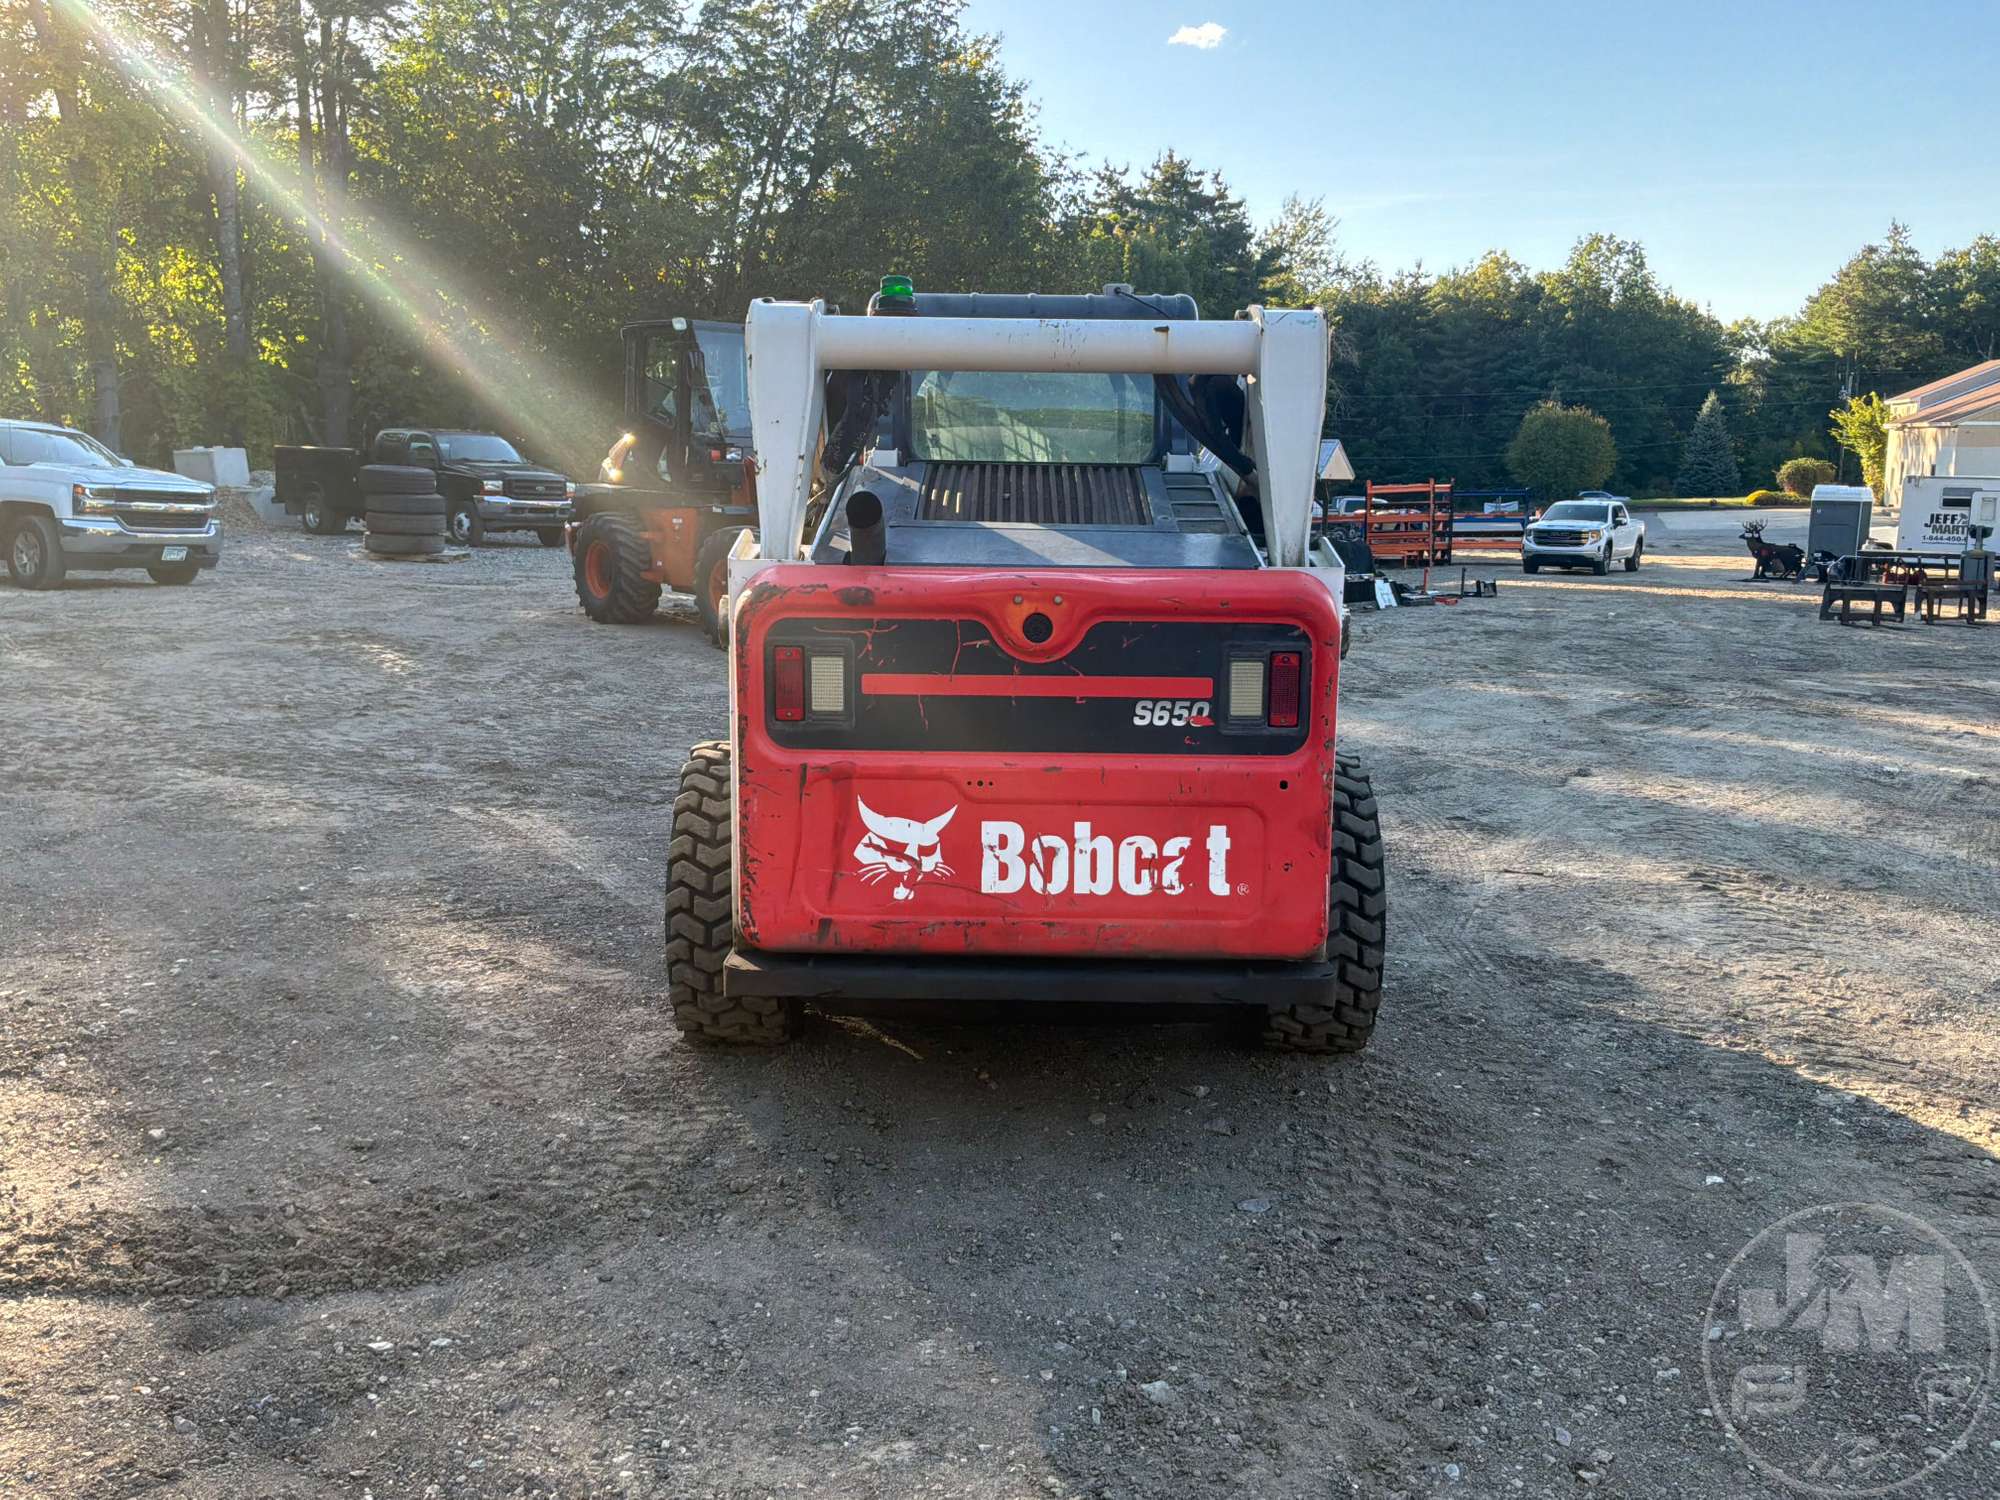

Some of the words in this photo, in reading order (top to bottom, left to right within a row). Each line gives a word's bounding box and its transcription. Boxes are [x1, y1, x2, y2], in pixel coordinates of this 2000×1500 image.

[1924, 513, 1958, 527] JEFF
[1931, 524, 1968, 535] MART
[1133, 700, 1210, 727] S650
[981, 821, 1231, 896] Bobcat
